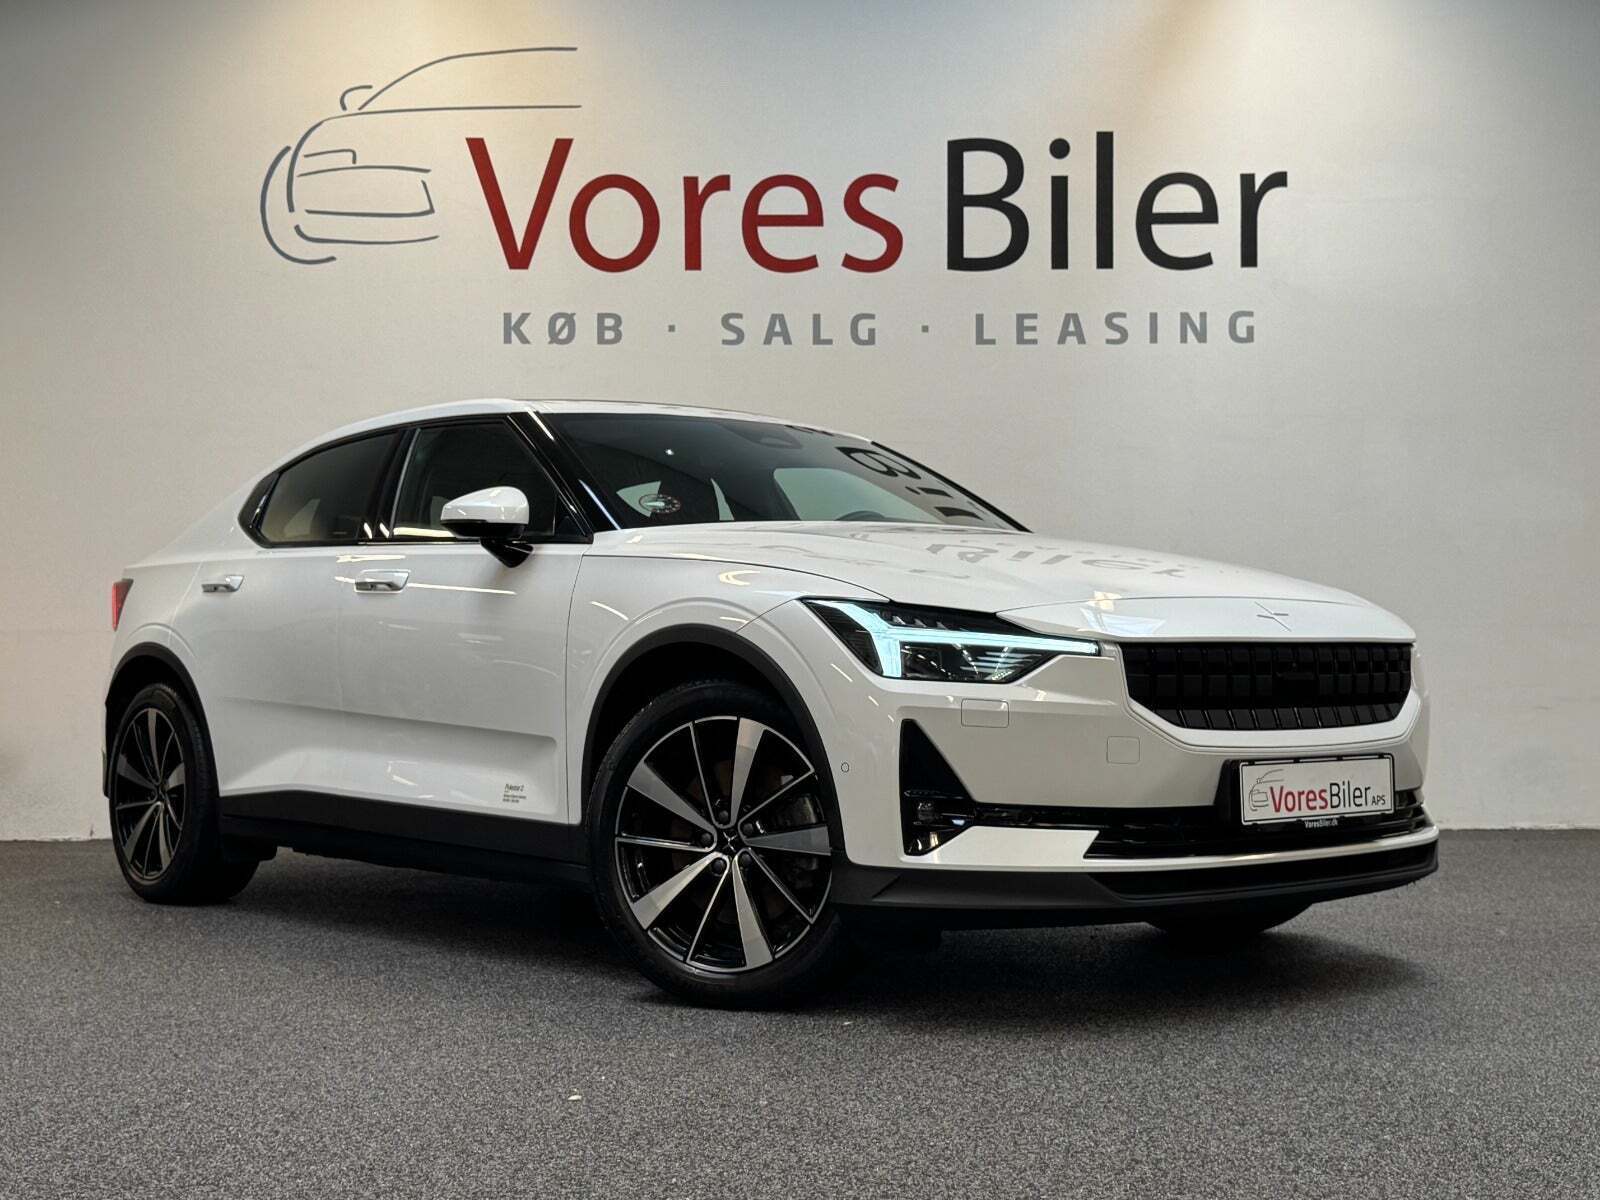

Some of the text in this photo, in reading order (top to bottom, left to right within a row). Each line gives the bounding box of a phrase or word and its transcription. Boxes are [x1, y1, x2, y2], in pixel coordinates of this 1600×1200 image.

[946, 131, 1288, 274] Biler
[503, 310, 1256, 346] KØB SALG LEASING
[1371, 795, 1386, 806] APS
